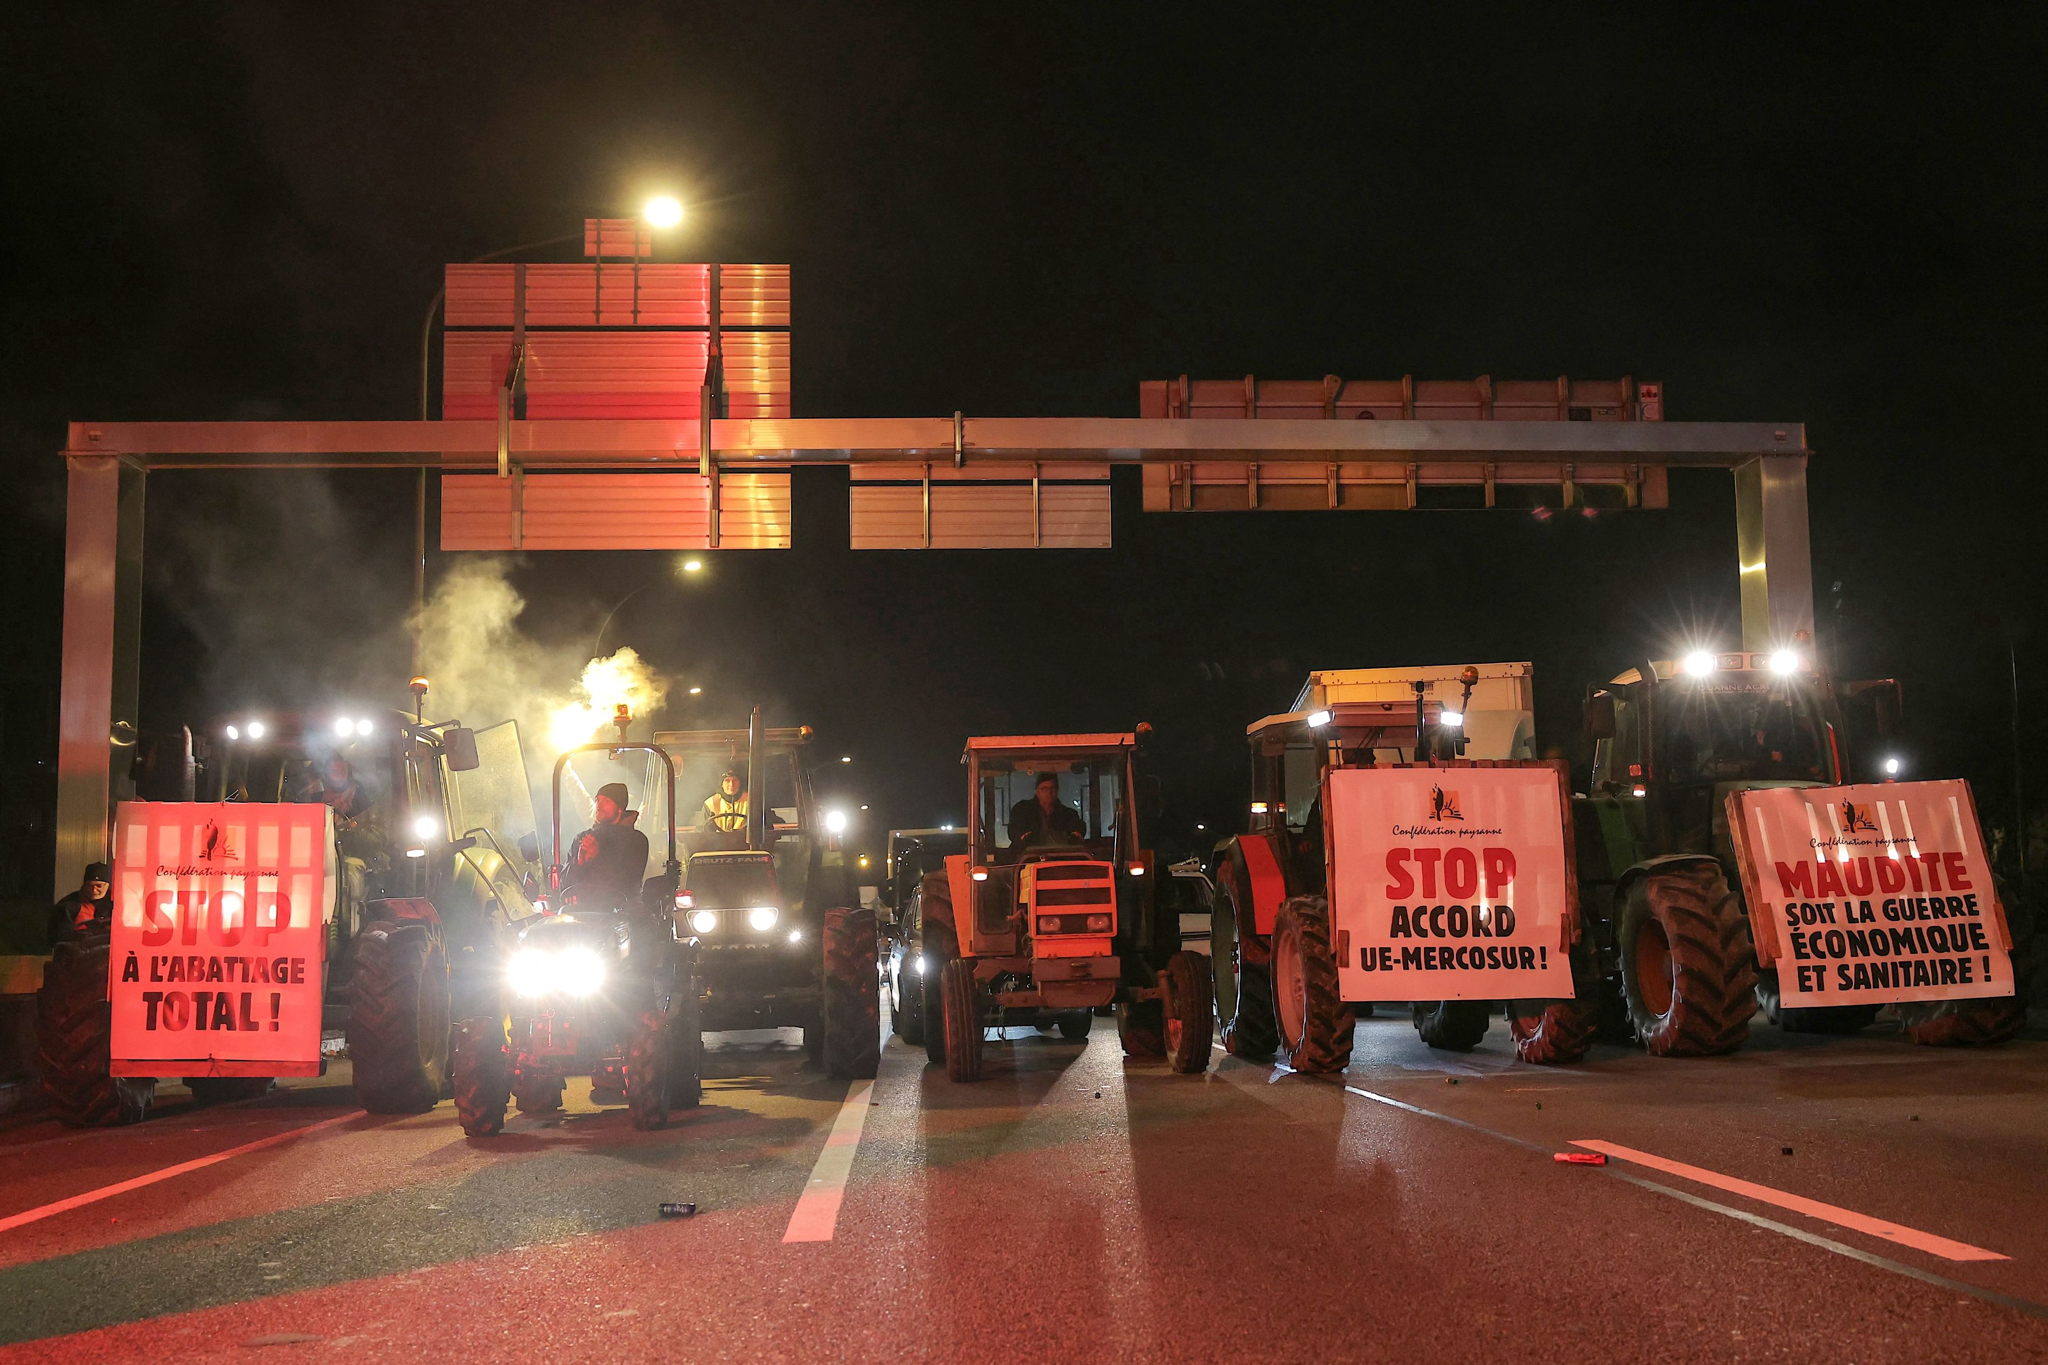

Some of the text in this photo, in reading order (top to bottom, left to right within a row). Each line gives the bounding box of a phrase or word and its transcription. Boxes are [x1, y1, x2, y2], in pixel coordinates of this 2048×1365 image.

[1392, 825, 1503, 840] Confédération paysanne
[1810, 834, 1918, 850] Confédération paysanne
[156, 865, 228, 880] Confédération
[1386, 847, 1517, 900] STOP
[1775, 852, 1973, 899] MAUDITE
[142, 890, 292, 948] STOP
[1390, 905, 1516, 938] ACCORD
[1785, 893, 1980, 927] SOIT LA GUERRE
[1790, 923, 1990, 960] ÉCONOMIQUE
[122, 951, 306, 984] À L'ABATTAGE
[1797, 965, 1827, 993] ET
[1837, 957, 1973, 991] SANITAIRE
[142, 991, 259, 1032] TOTAL
